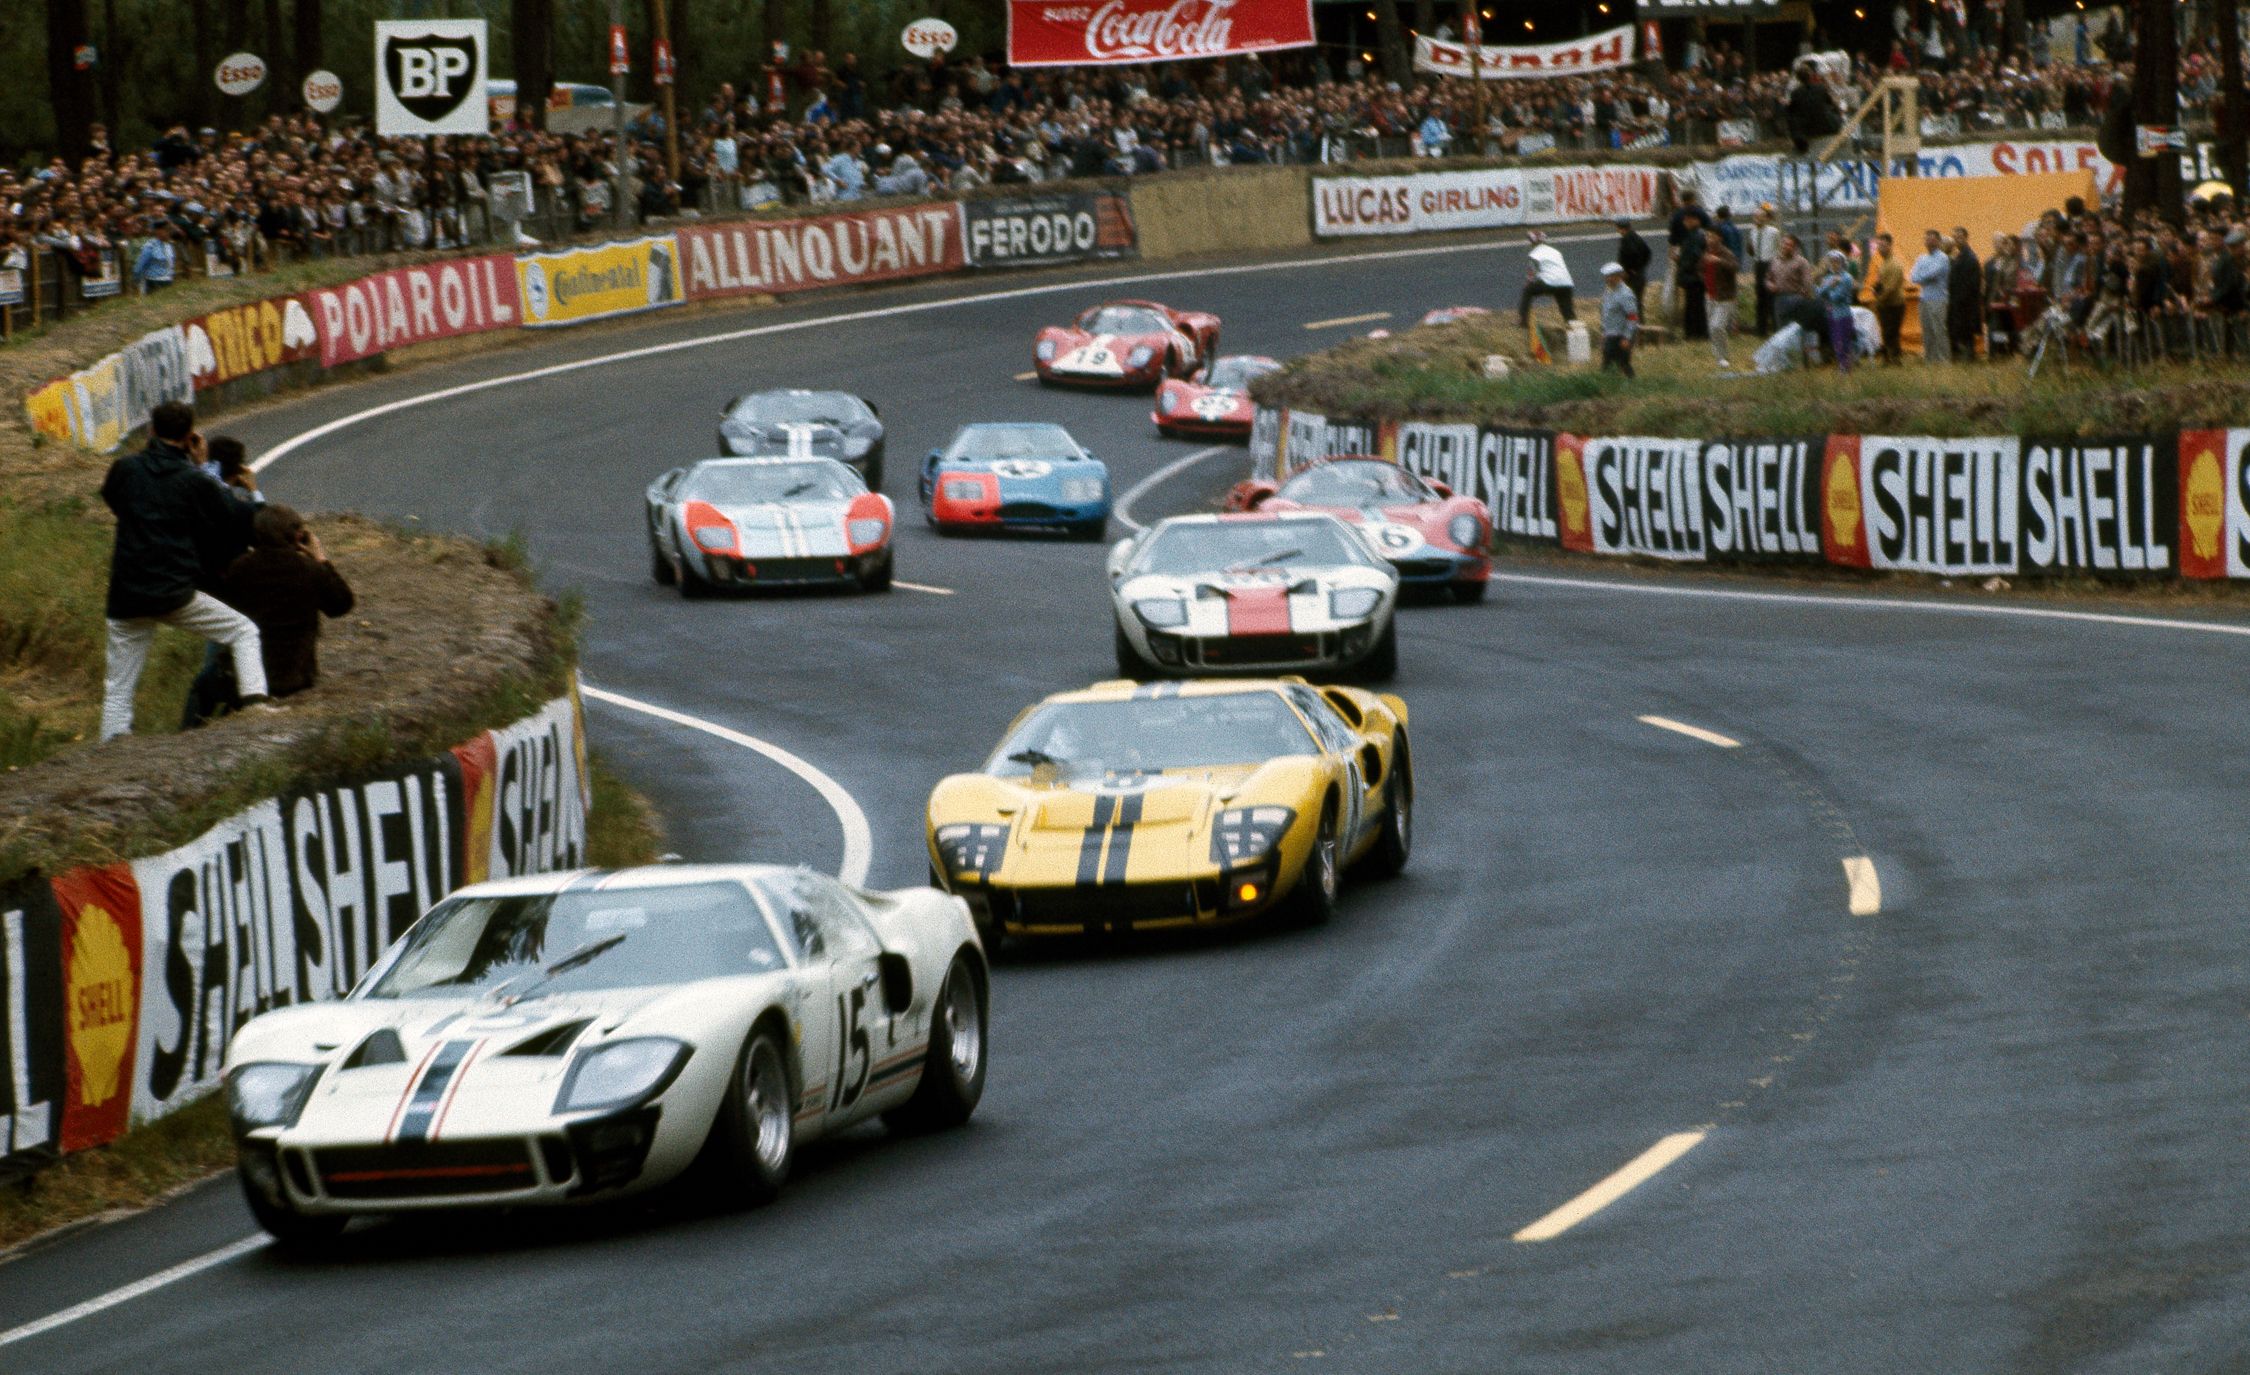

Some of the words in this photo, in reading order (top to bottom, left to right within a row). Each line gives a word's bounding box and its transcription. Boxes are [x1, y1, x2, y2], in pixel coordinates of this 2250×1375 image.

[395, 48, 470, 97] BP
[690, 210, 950, 292] ALLINQUANT
[971, 212, 1095, 258] FERODO
[1322, 187, 1410, 224] LUCAS
[1420, 185, 1519, 214] GIRLING
[319, 259, 514, 360] POLAROIL
[1480, 431, 1557, 537] SHELL
[1597, 444, 1703, 552] SHELL
[1705, 443, 1819, 553] SHELL
[1872, 448, 2013, 566] SHELL
[2026, 444, 2170, 569] SHELL
[79, 979, 125, 1030] SHELL
[150, 826, 292, 1101] SHELL
[828, 984, 871, 1113] 15
